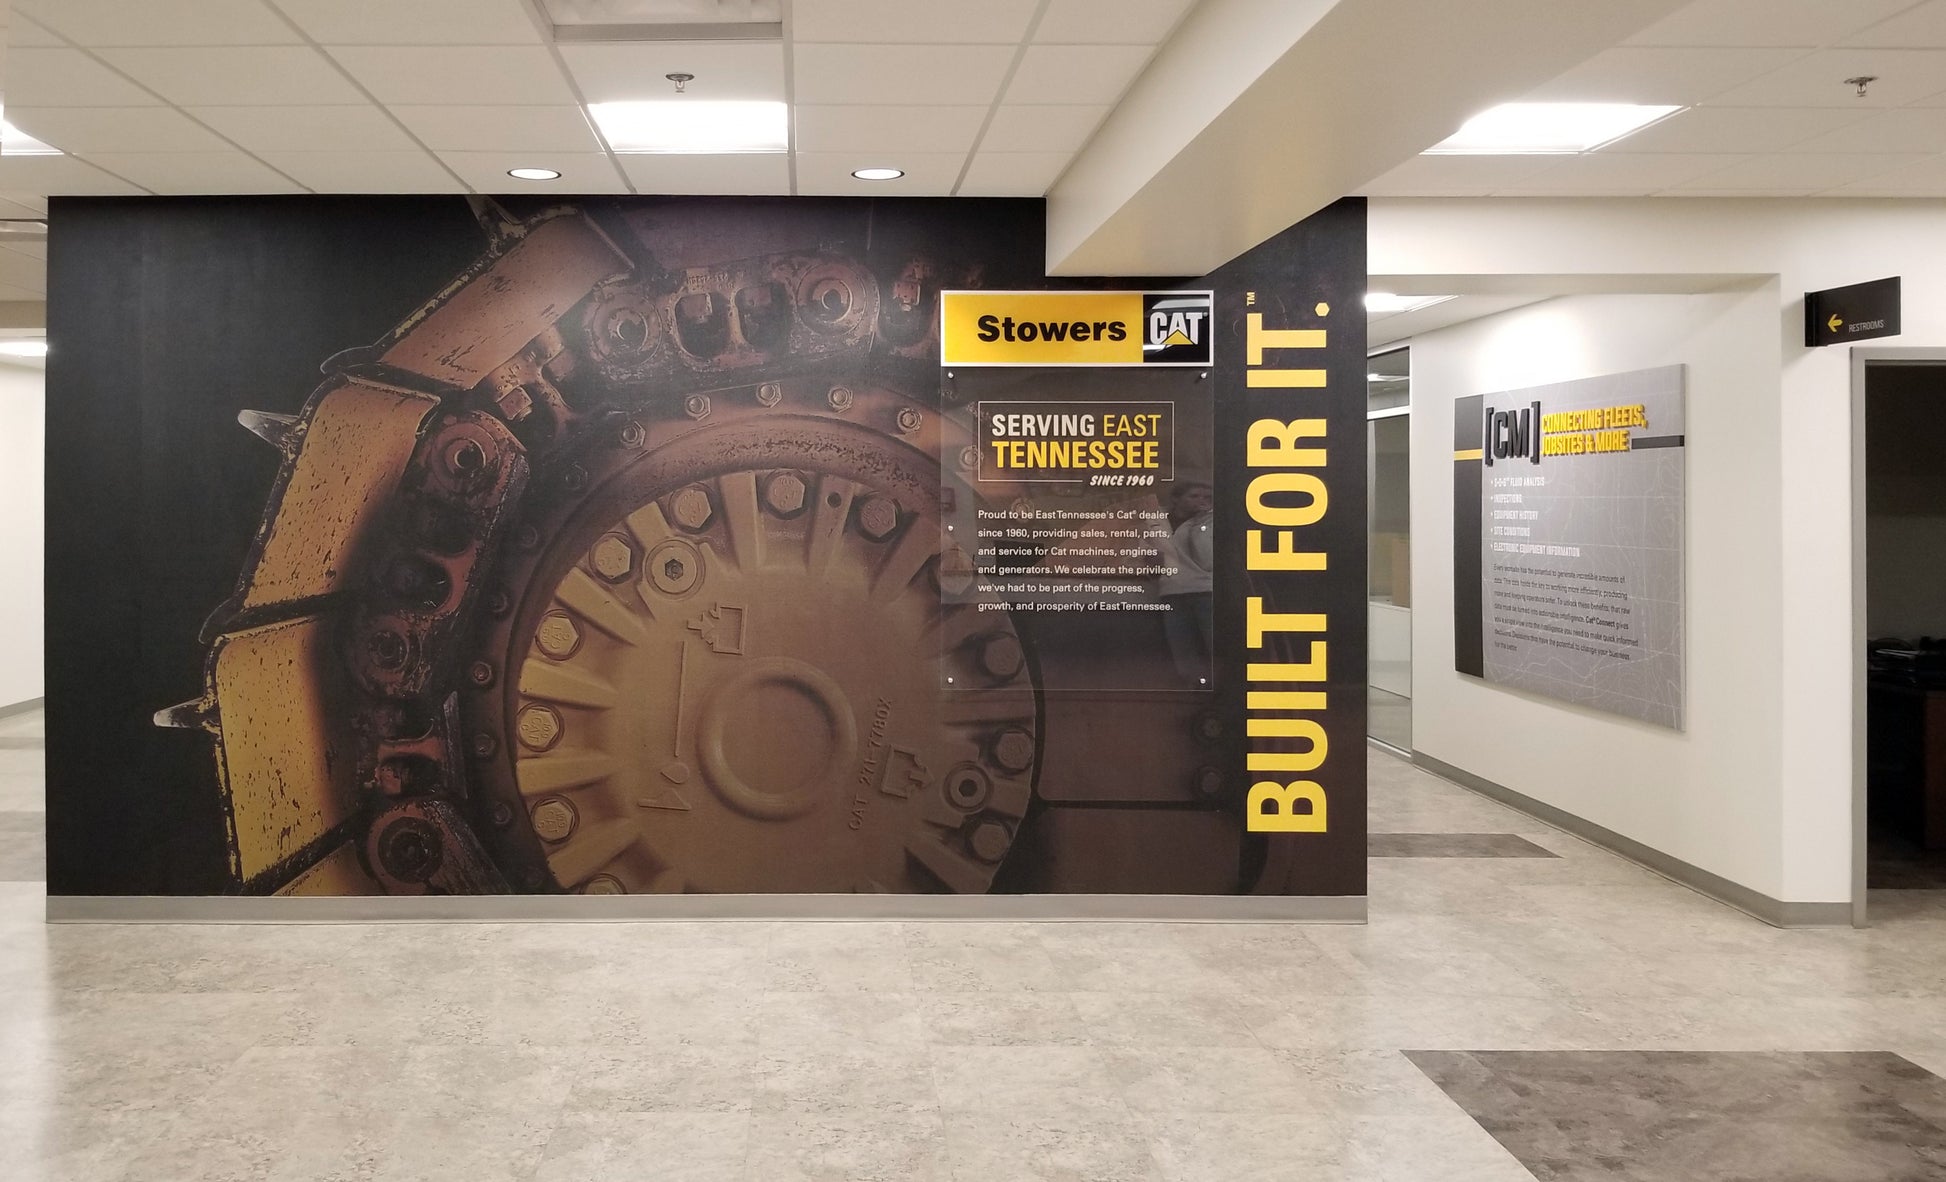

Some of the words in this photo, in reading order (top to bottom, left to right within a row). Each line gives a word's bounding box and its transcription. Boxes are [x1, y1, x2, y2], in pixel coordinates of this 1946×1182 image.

[977, 314, 1127, 342] Stowers
[1150, 311, 1204, 345] CAT
[1848, 319, 1885, 333] RESTROOMS
[1246, 302, 1330, 388] IT.
[1541, 408, 1605, 434] CONNECTING
[1604, 404, 1648, 429] FLEETS,
[992, 414, 1095, 437] SERVING
[1103, 414, 1162, 437] EAST
[1541, 434, 1586, 457] JOBSITES
[1585, 433, 1597, 454] &
[1595, 429, 1630, 453] MORE
[992, 441, 1159, 469] TENNESSEE
[1089, 475, 1124, 487] SINCE
[1125, 475, 1155, 487] 1960
[1523, 476, 1545, 487] ANALYSIS
[1246, 418, 1329, 571] FOR
[978, 509, 1006, 520] Proud
[1009, 510, 1018, 519] to
[1021, 509, 1033, 520] be
[1036, 509, 1056, 520] East
[1056, 509, 1114, 520] Tennessee's
[1139, 510, 1170, 520] dealer
[1493, 509, 1519, 520] EQUIPMENT
[1519, 510, 1539, 521] HISTORY
[978, 528, 1003, 538] since
[1006, 528, 1030, 538] 1960,
[1033, 528, 1078, 539] providing
[1080, 528, 1108, 538] sales,
[1110, 528, 1140, 539] rental,
[1143, 529, 1170, 539] parts,
[978, 546, 996, 556] and
[999, 546, 1032, 556] service
[1035, 546, 1049, 556] for
[1051, 546, 1067, 556] Cat
[1069, 546, 1117, 557] machines,
[1119, 547, 1158, 558] engines
[1493, 542, 1519, 553] ELECTRONIC
[1519, 543, 1546, 555] EQUIPMENT
[1546, 545, 1580, 557] INFORMATION
[978, 564, 996, 574] and
[999, 565, 1053, 576] generators.
[1054, 565, 1070, 574] We
[1072, 565, 1116, 574] celebrate
[1118, 565, 1134, 574] the
[1136, 565, 1178, 576] privilege
[1598, 574, 1618, 583] amounts
[978, 583, 1005, 592] we've
[1007, 583, 1025, 592] had
[1027, 583, 1037, 592] to
[1039, 583, 1051, 592] be
[1053, 584, 1071, 594] part
[1073, 583, 1083, 592] of
[1084, 583, 1100, 592] the
[1101, 584, 1145, 594] progress,
[1603, 589, 1627, 600] producing
[978, 601, 1014, 612] growth,
[1016, 601, 1034, 611] and
[1036, 602, 1085, 612] prosperity
[1087, 601, 1098, 611] of
[1100, 601, 1120, 611] East
[1120, 601, 1174, 611] Tennessee.
[1596, 618, 1614, 627] Connect
[1616, 636, 1638, 647] informed
[1246, 596, 1329, 833] BUILT
[848, 792, 867, 831] CAT
